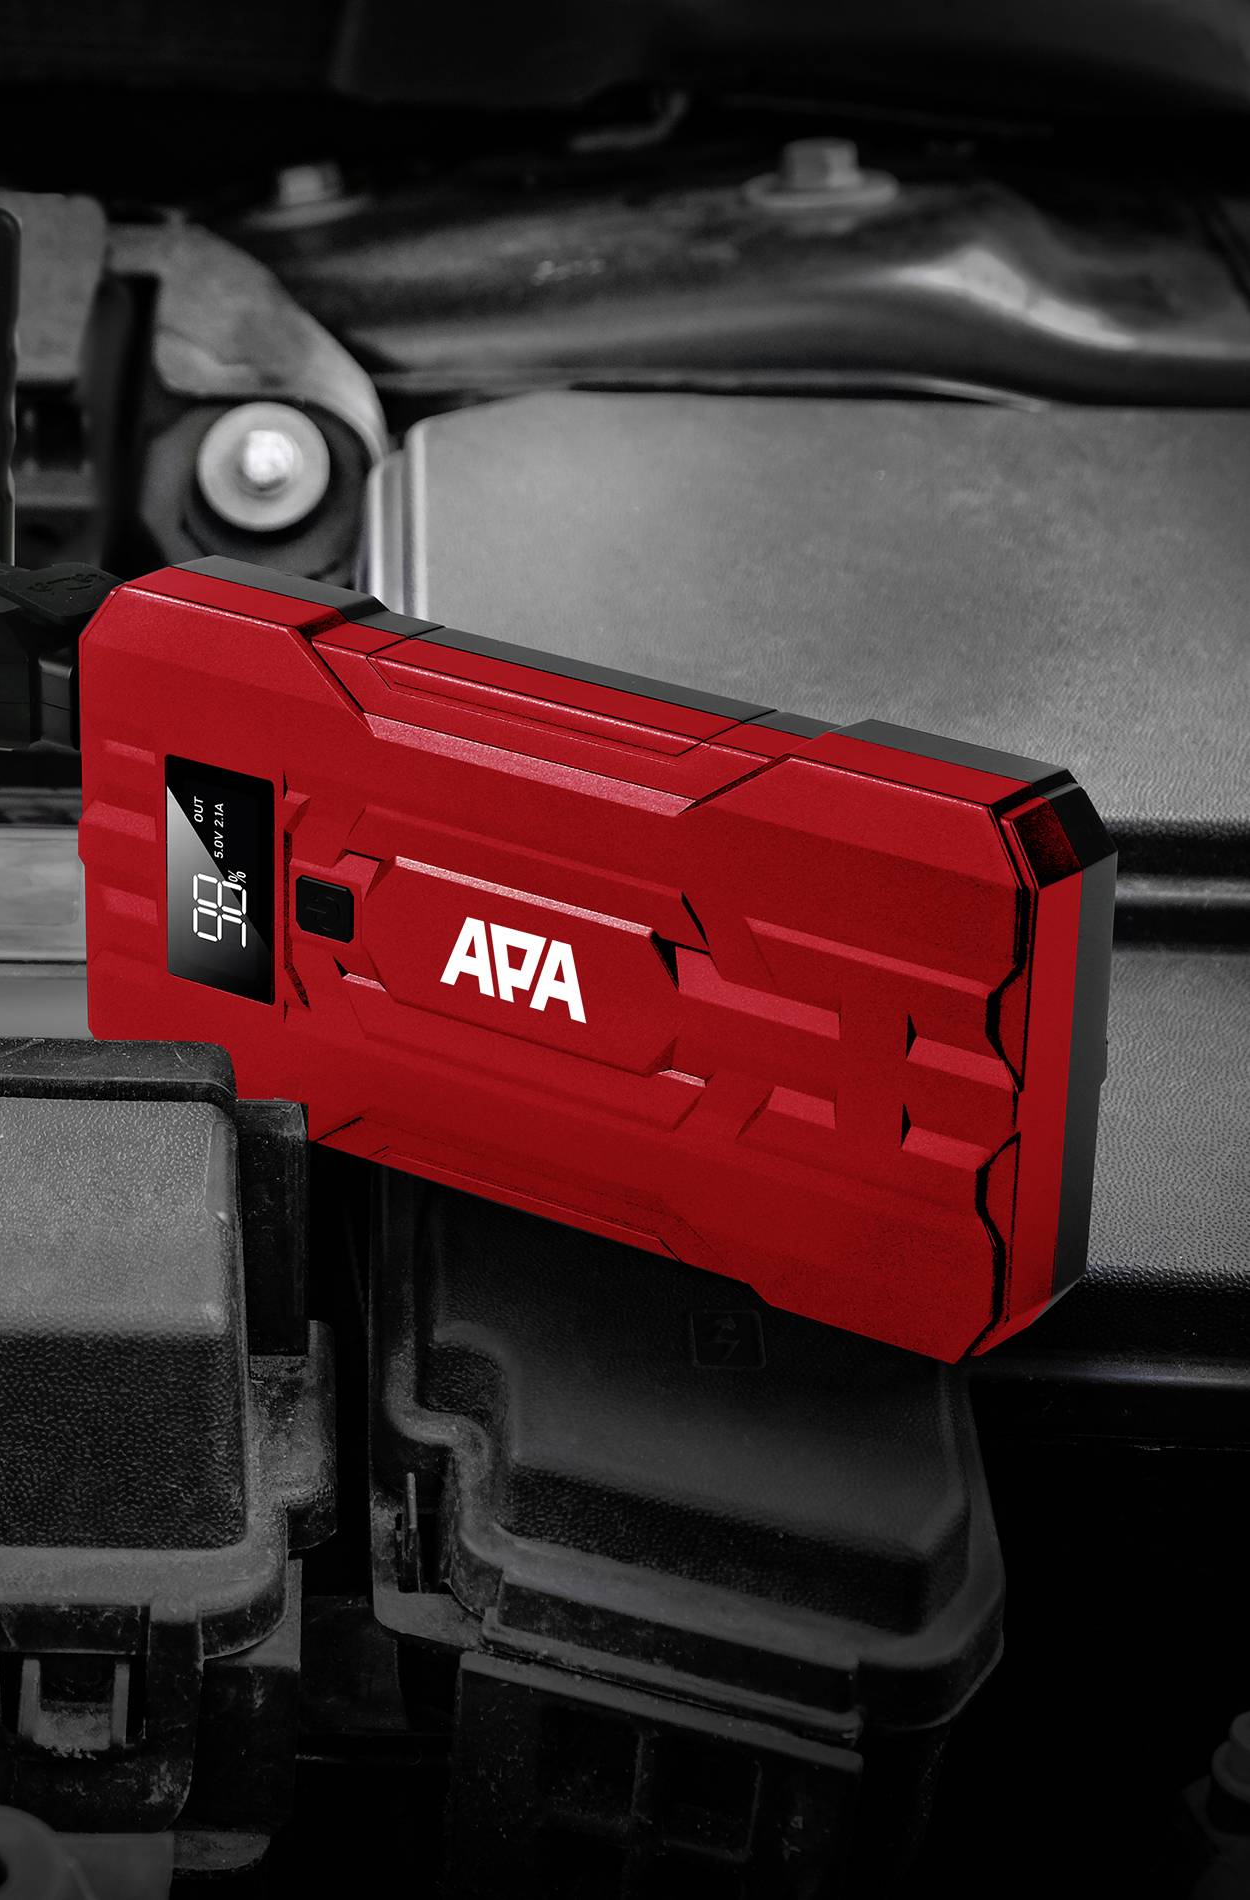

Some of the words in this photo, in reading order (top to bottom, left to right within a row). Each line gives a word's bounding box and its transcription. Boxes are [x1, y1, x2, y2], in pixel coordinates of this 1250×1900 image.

[194, 796, 203, 822] OUT
[214, 803, 223, 828] 2.1A
[214, 831, 223, 858] 5.0V
[440, 917, 587, 1024] APA
